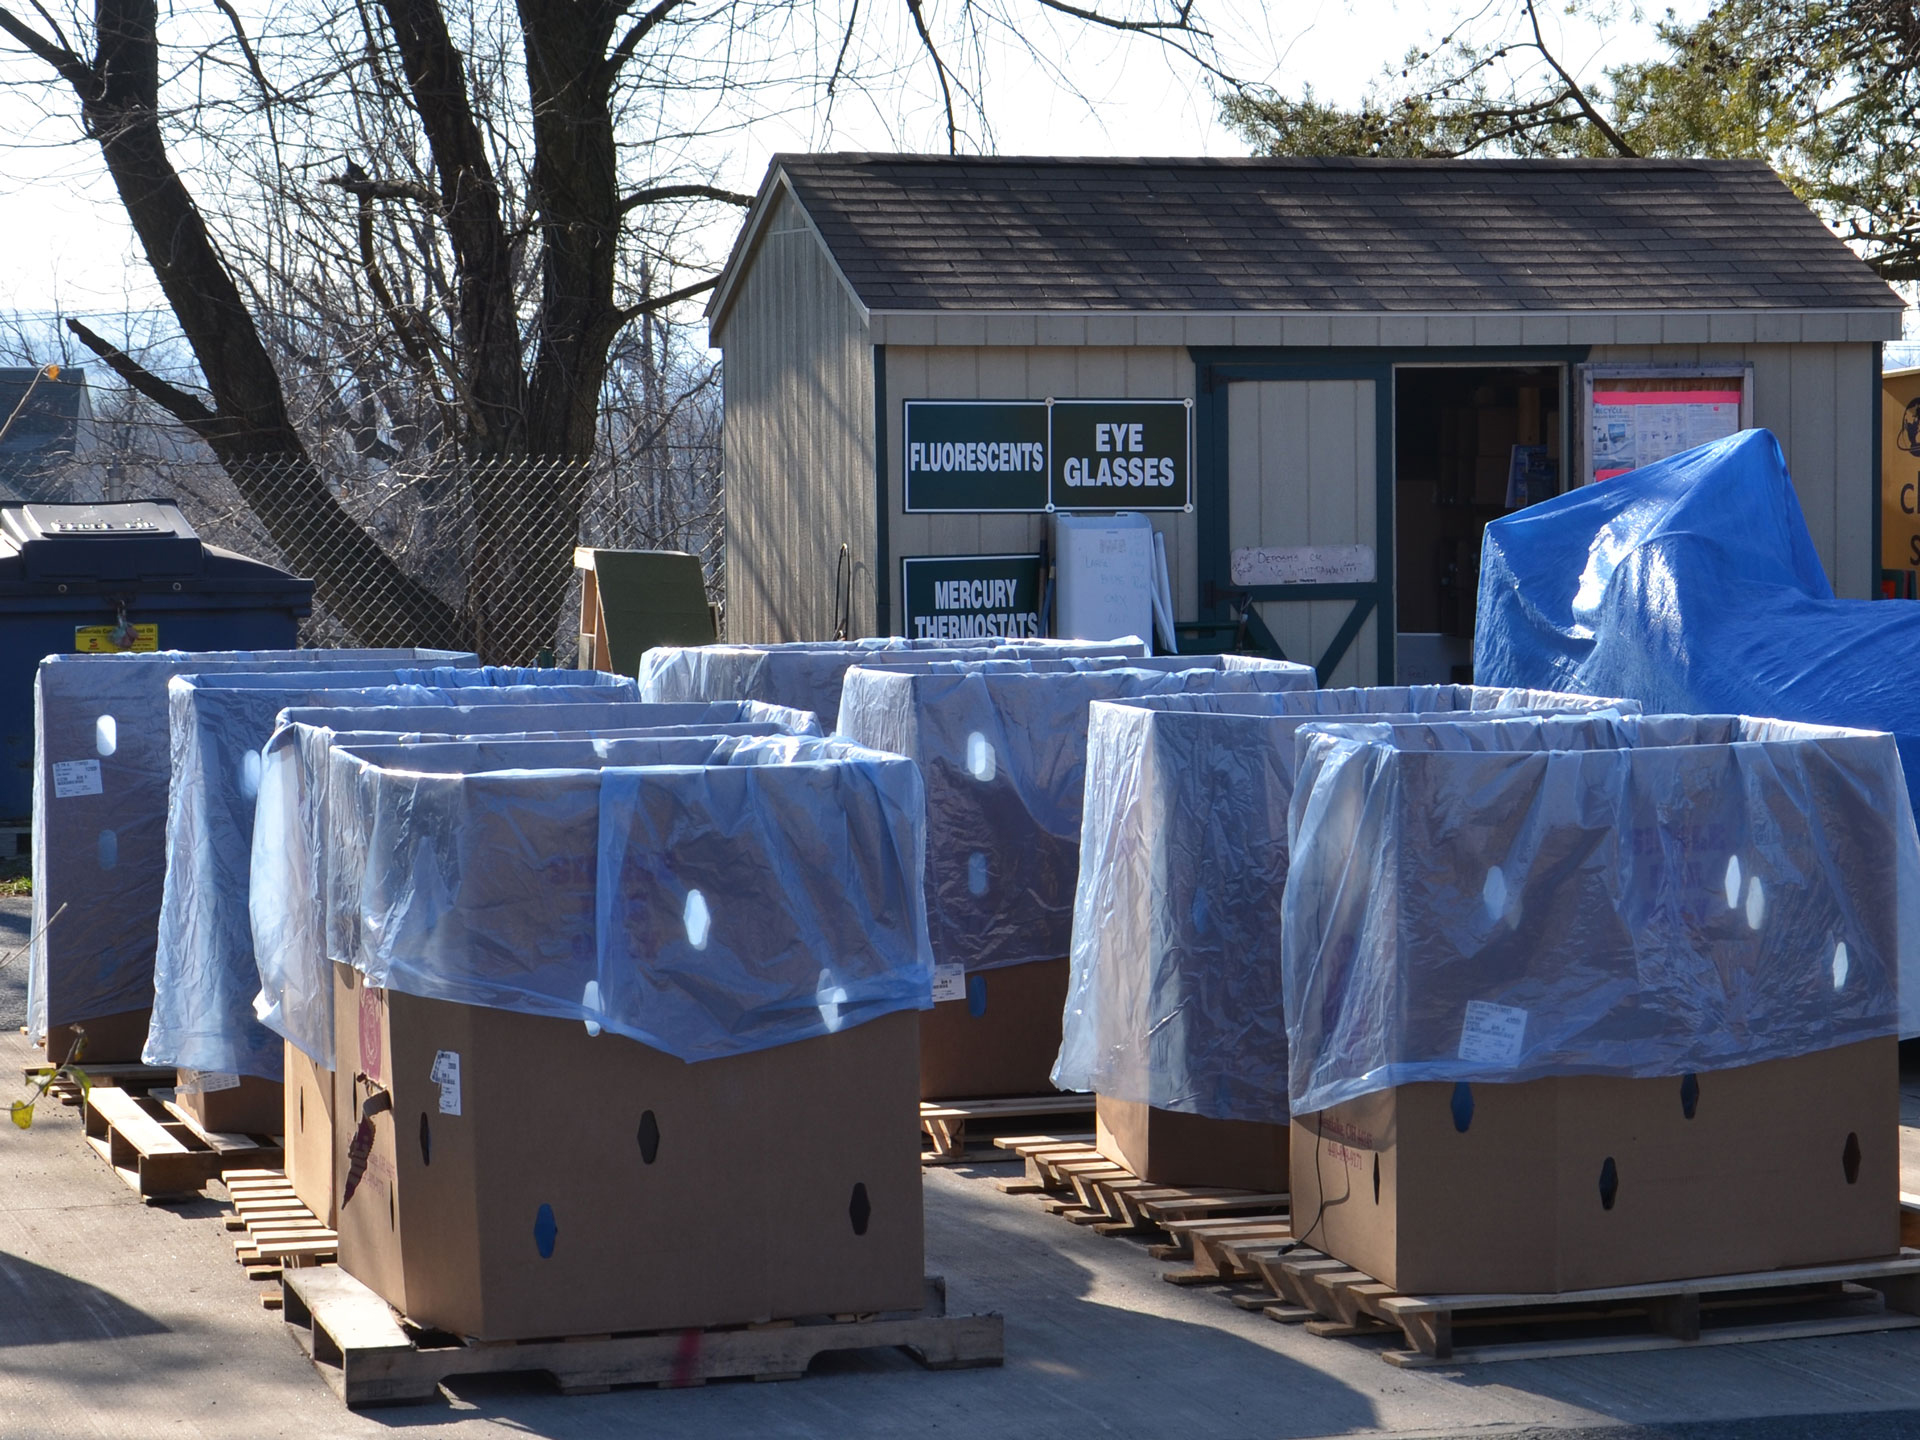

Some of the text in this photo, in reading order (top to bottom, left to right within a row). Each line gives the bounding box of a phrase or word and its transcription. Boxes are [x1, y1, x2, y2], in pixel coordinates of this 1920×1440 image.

[1095, 423, 1144, 452] EYE
[910, 441, 1044, 472] FLUORESCENTS
[1063, 456, 1175, 487] GLASSES
[934, 578, 1017, 610] MERCURY
[914, 612, 1039, 639] THERMOSTATS
